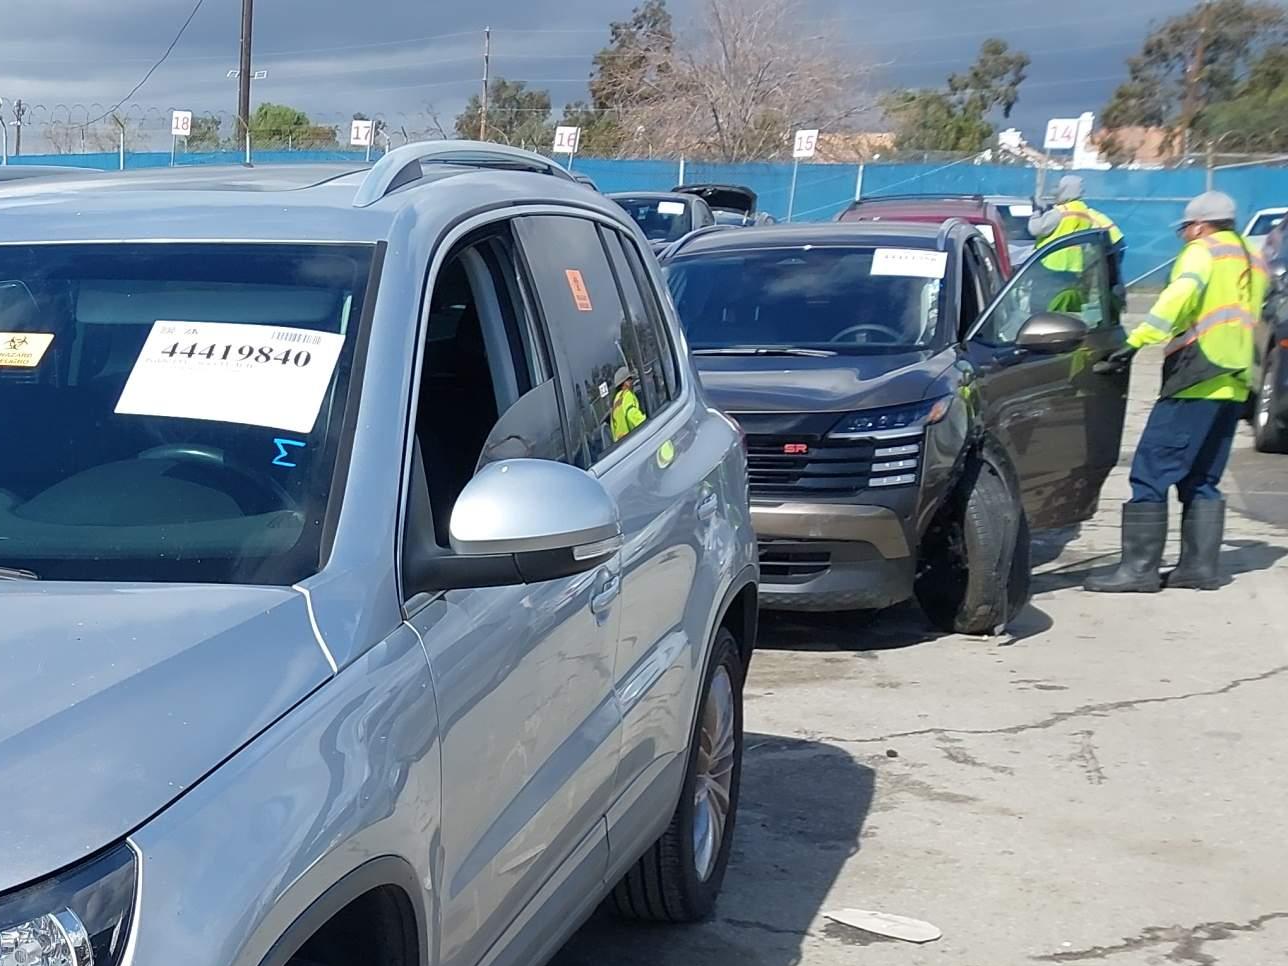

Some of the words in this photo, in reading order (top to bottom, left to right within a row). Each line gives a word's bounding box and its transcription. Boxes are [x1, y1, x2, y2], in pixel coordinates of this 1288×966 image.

[173, 116, 189, 131] 18
[353, 125, 372, 141] 17
[556, 132, 576, 148] 16
[1049, 125, 1072, 142] 14
[795, 135, 815, 152] 15
[161, 341, 312, 368] 44419840
[784, 443, 808, 454] SR
